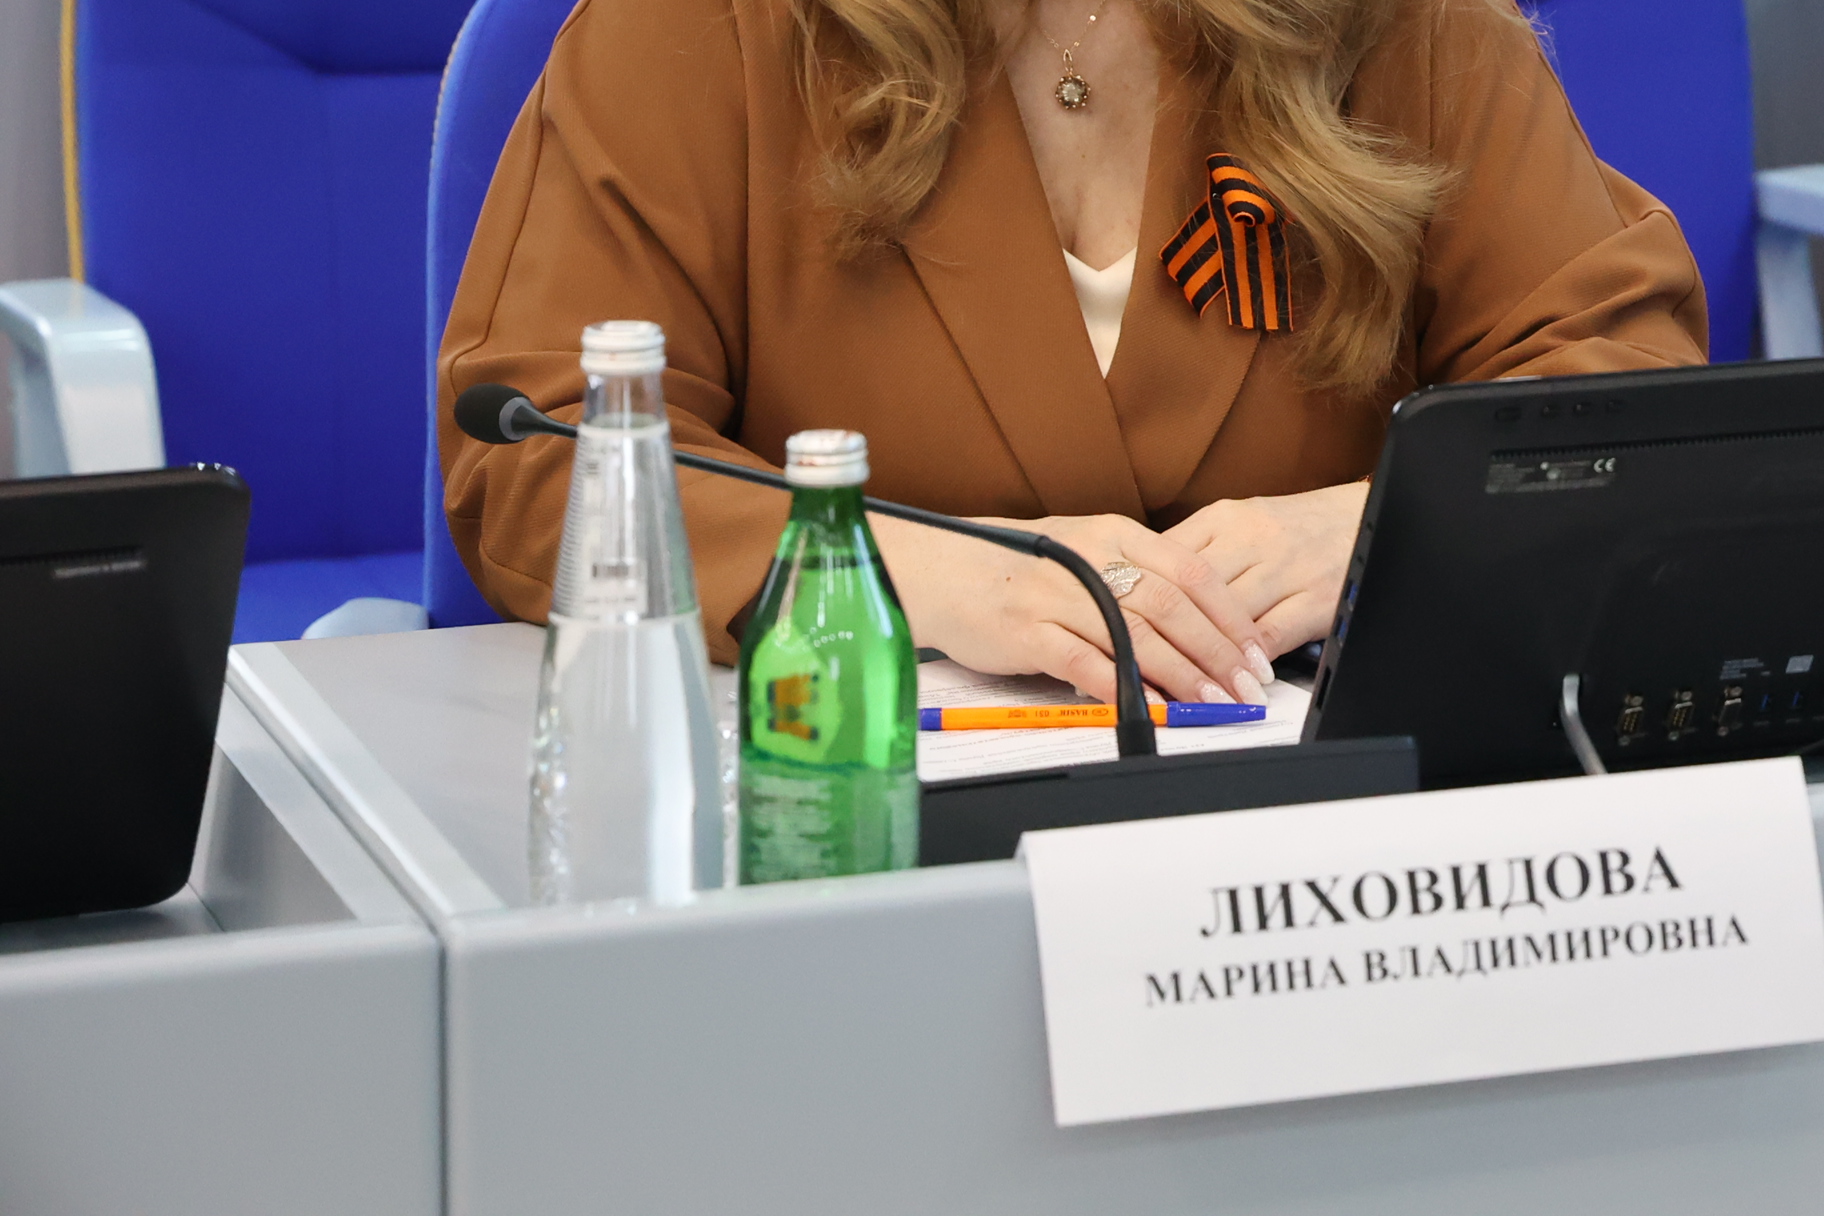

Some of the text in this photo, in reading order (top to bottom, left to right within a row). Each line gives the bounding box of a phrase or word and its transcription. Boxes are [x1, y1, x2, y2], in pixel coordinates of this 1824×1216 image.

[1200, 845, 1683, 939] ЛИХОВИДОВА
[1144, 914, 1750, 1007] МАРИНА ВЛАДИМИРОВНА
